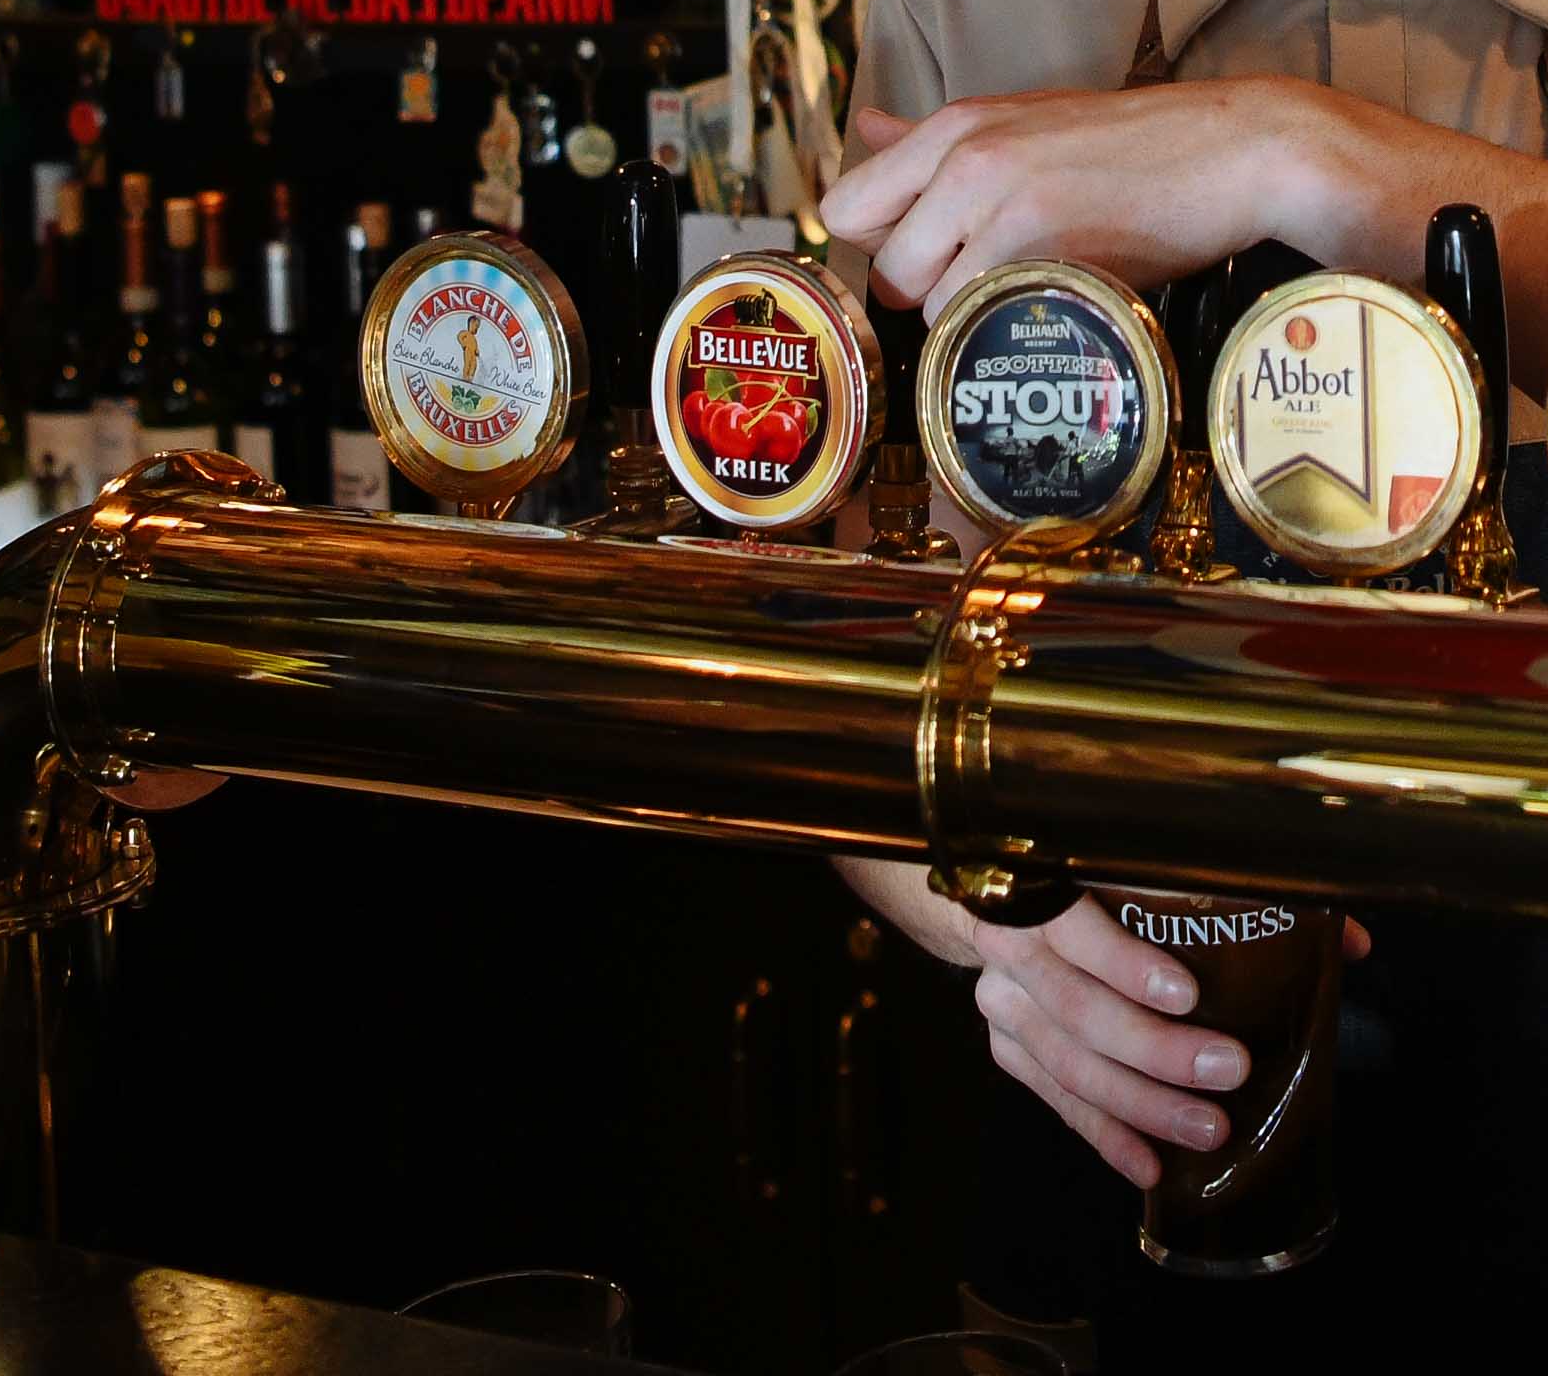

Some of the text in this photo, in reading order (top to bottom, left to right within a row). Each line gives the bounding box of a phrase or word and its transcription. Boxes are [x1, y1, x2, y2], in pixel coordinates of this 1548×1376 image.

[407, 287, 535, 375] BLANCHE DE
[1009, 322, 1072, 343] BELHAVEN
[1024, 339, 1058, 348] BREWERY
[393, 339, 461, 375] Bière Blanche
[698, 329, 810, 371] BELLE-VUE
[975, 353, 1116, 380] SCOTTISH
[489, 364, 548, 401] White Beer
[1249, 347, 1358, 403] Abbot
[406, 370, 525, 445] BRUXELLES
[955, 379, 1137, 428] STOUT
[1282, 399, 1324, 416] ALE
[714, 455, 792, 484] KRIEK
[1121, 902, 1296, 946] GUINNESS
